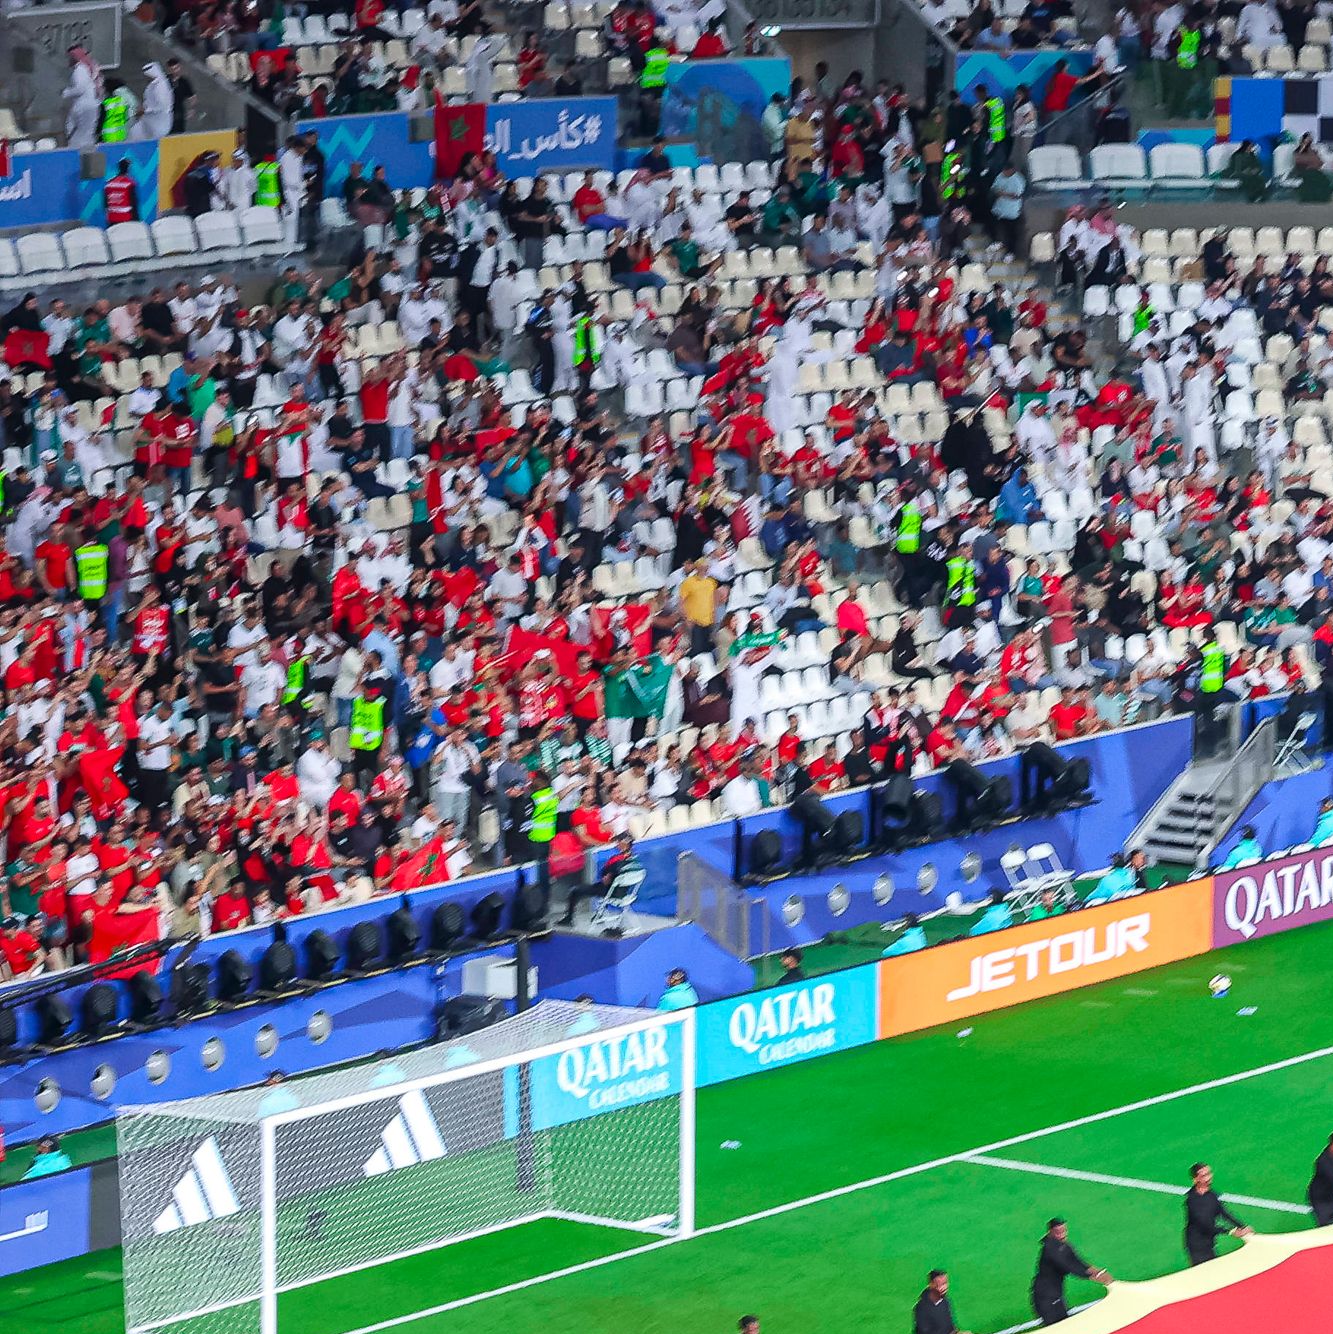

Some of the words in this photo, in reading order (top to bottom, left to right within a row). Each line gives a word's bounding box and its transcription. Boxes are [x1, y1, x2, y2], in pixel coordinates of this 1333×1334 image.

[946, 911, 1151, 1003] JETOUR
[728, 982, 836, 1054] QATAR
[556, 1024, 670, 1099] QATAR
